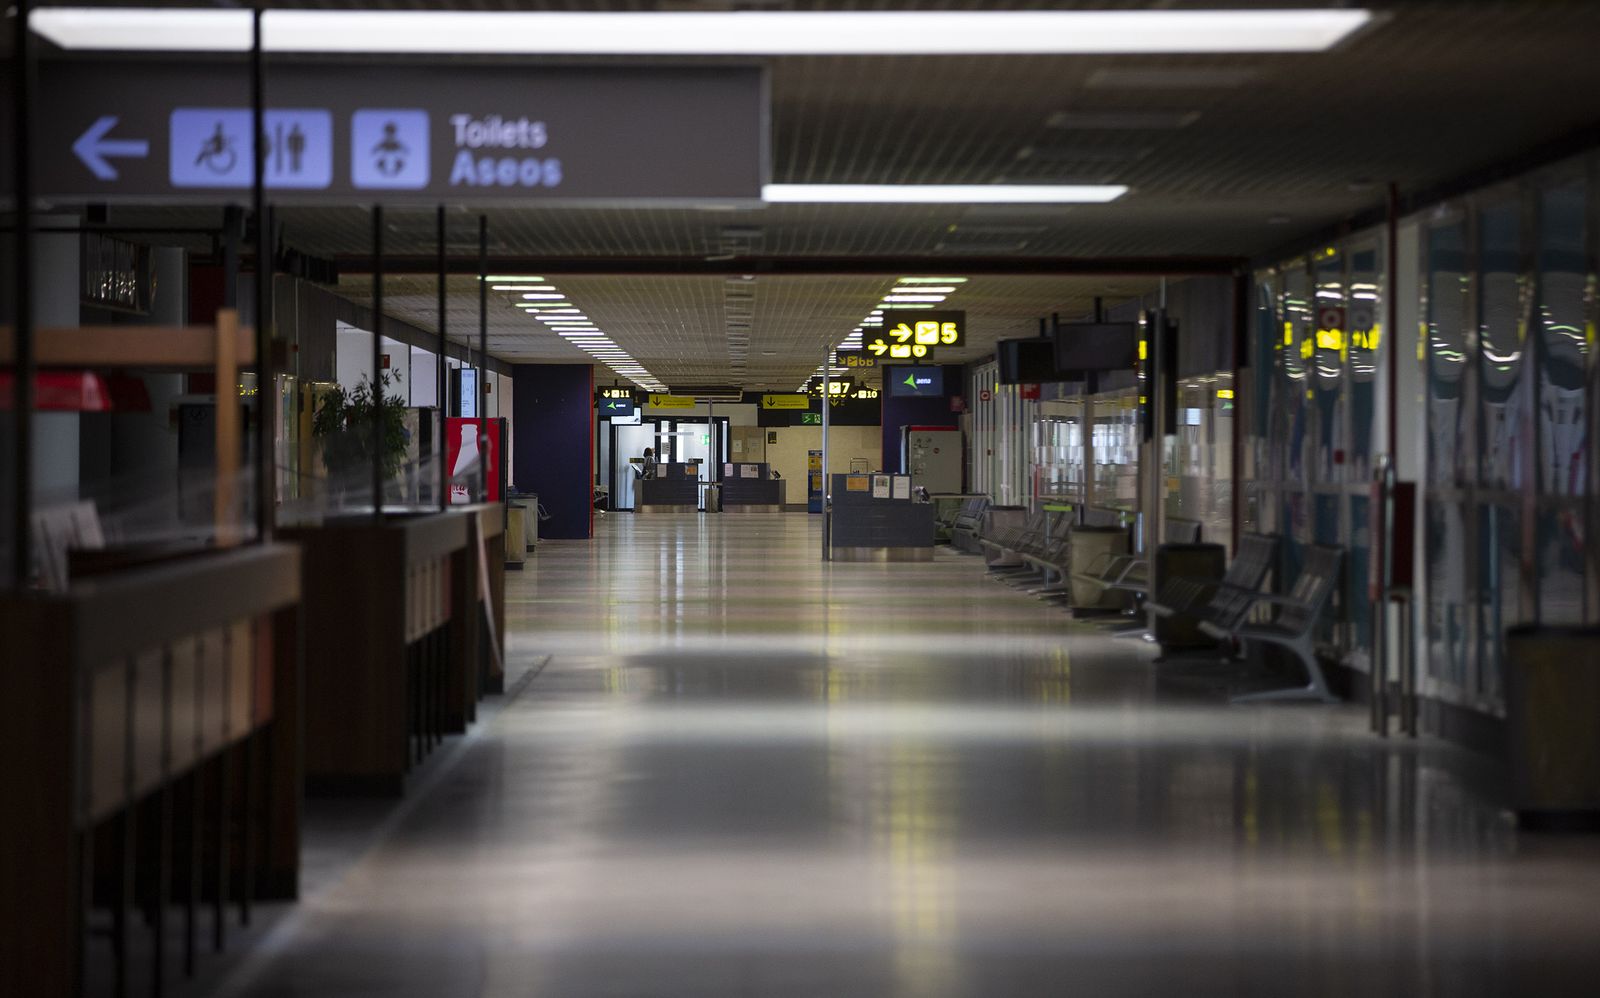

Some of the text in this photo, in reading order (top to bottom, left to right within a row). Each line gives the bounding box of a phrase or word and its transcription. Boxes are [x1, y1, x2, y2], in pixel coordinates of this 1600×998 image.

[449, 114, 547, 147] Toilets
[449, 151, 562, 186] Aseos
[940, 321, 958, 344] 5
[841, 382, 851, 394] 7
